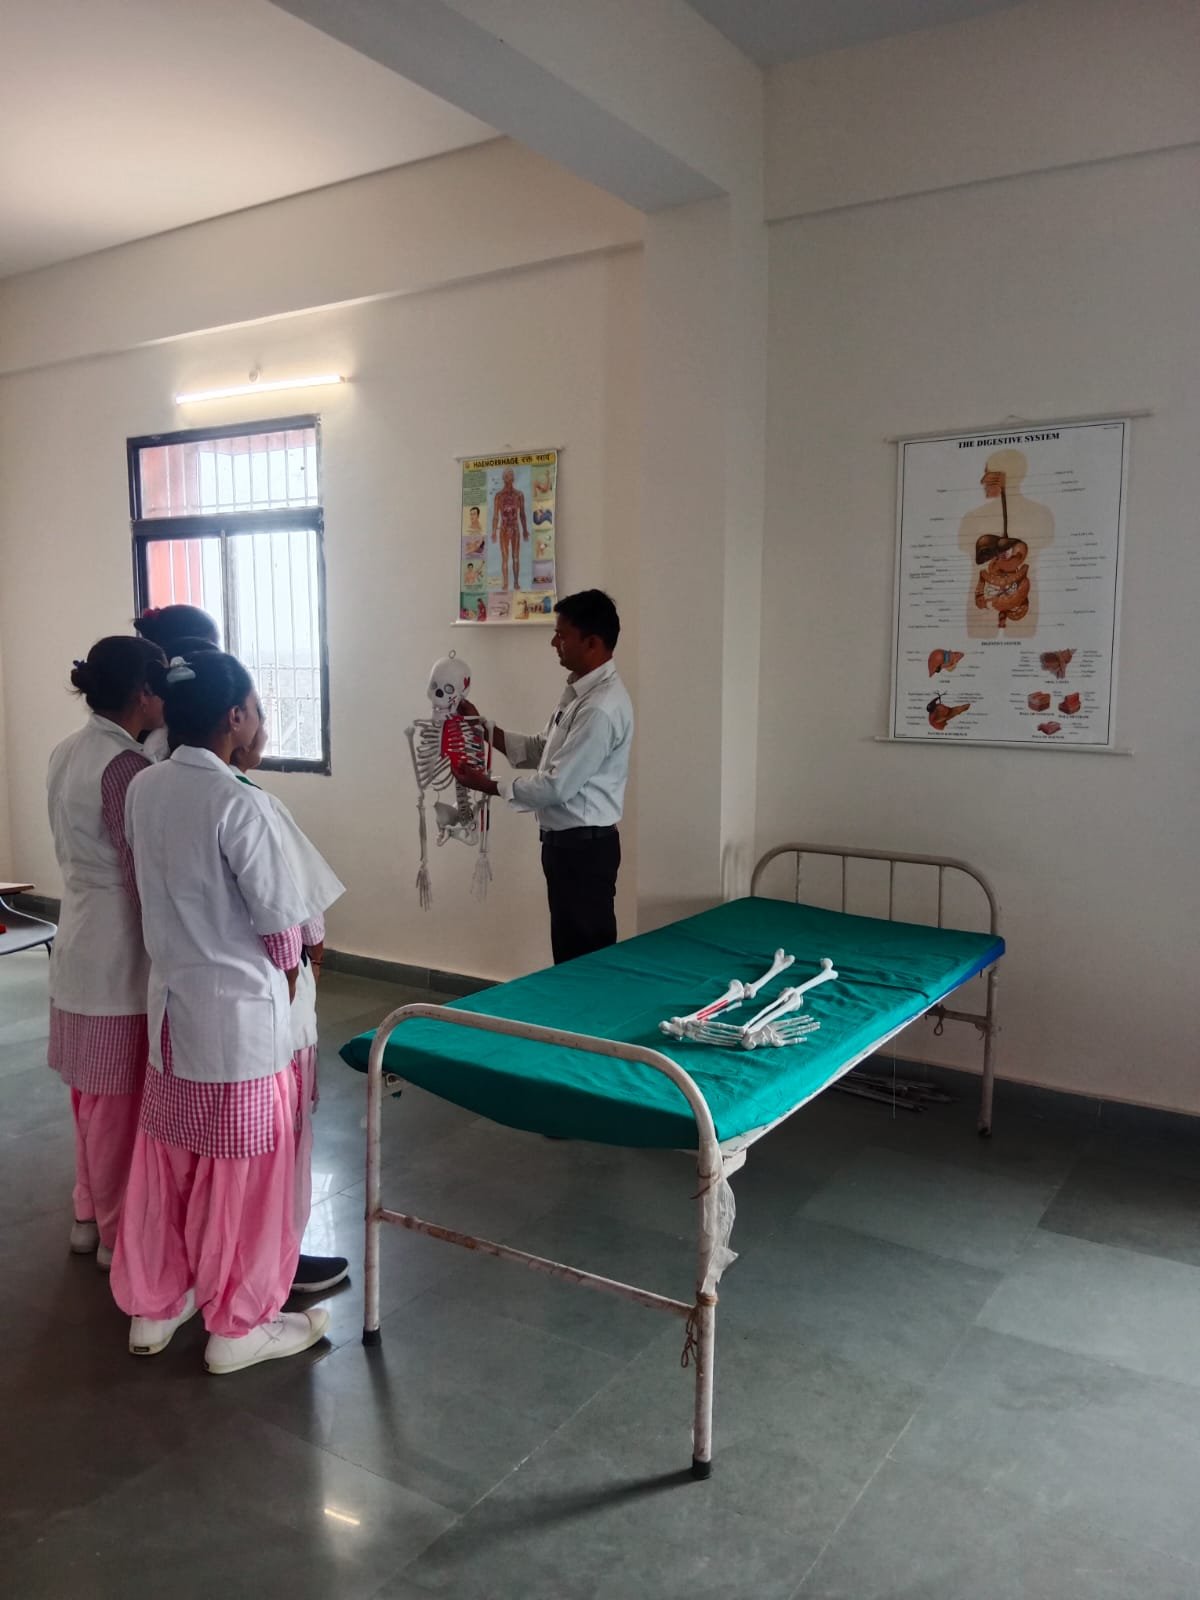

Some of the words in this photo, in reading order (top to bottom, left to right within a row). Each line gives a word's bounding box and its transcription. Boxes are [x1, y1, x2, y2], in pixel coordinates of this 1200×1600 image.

[977, 436, 1022, 447] DIGESTIVE
[1024, 432, 1060, 442] SYSTEM
[473, 457, 518, 469] HAEMORRHAGE
